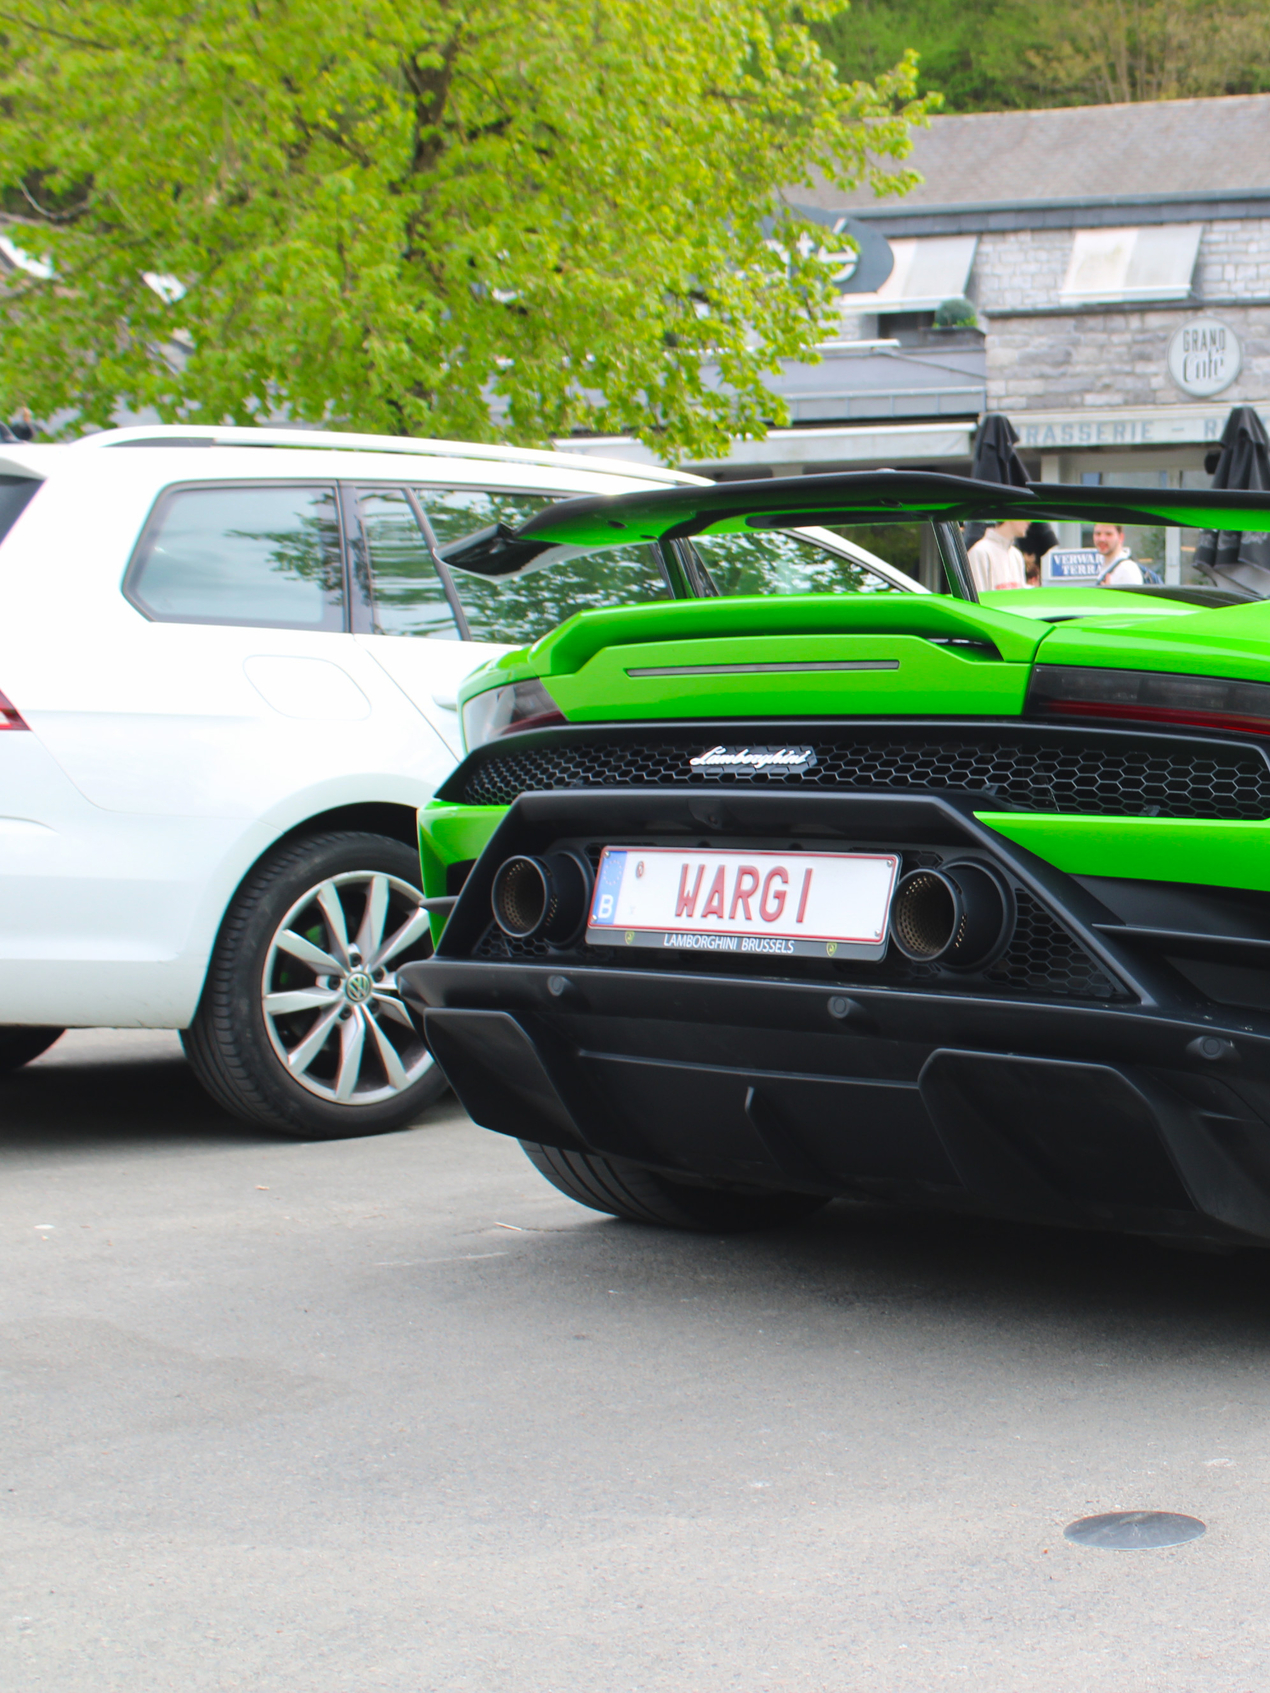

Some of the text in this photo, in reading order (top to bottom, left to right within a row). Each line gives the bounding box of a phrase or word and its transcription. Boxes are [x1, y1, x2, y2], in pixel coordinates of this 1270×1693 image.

[1183, 327, 1226, 352] GRAND
[690, 745, 811, 769] Lamborghini
[598, 894, 614, 918] B
[663, 933, 795, 954] LAMBORGHINI BRUSSELS
